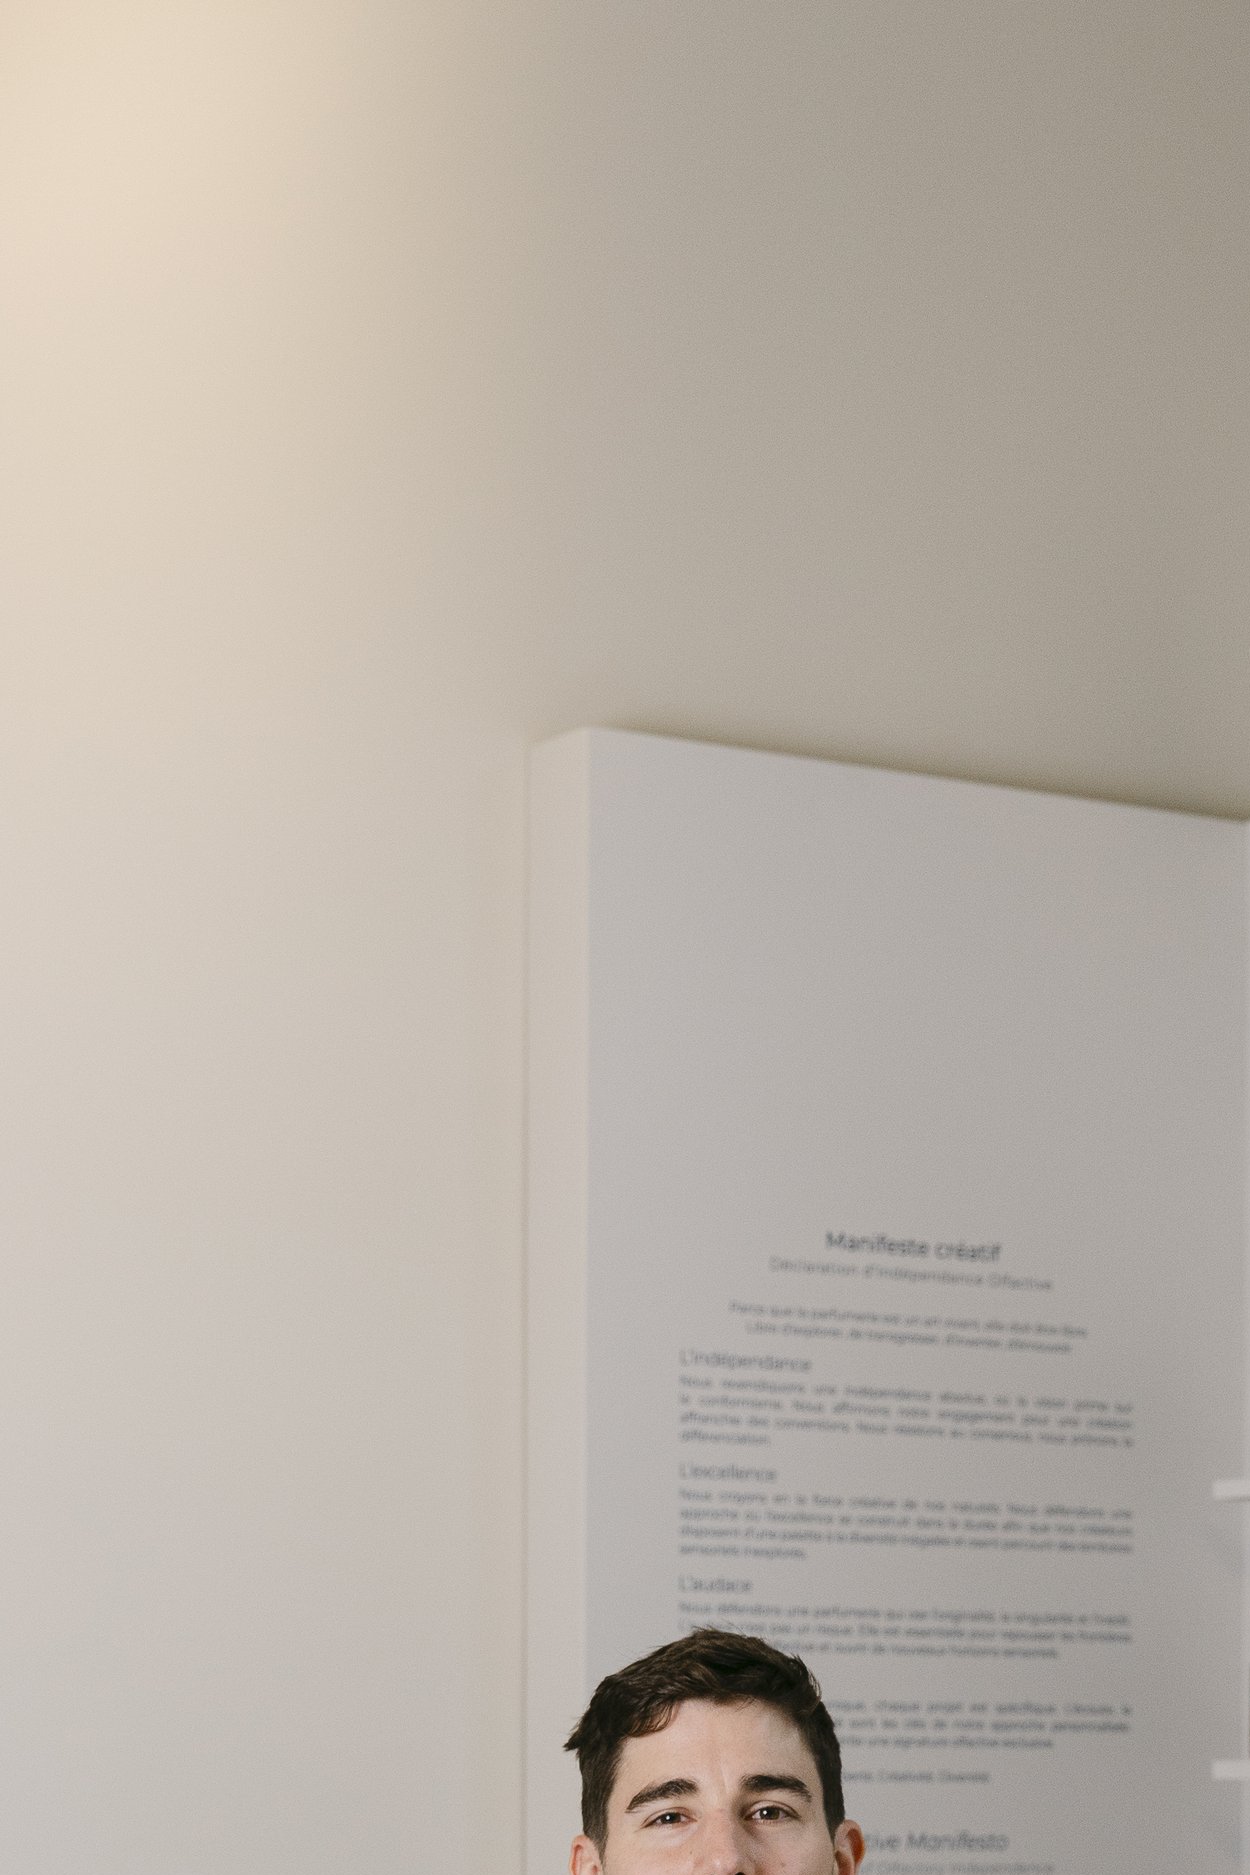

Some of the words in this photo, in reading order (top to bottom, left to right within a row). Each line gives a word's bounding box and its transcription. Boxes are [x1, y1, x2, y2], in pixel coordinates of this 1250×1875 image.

[825, 1231, 929, 1259] Manifeste
[934, 1240, 1002, 1263] créatif
[906, 1830, 1010, 1852] Manifesto
